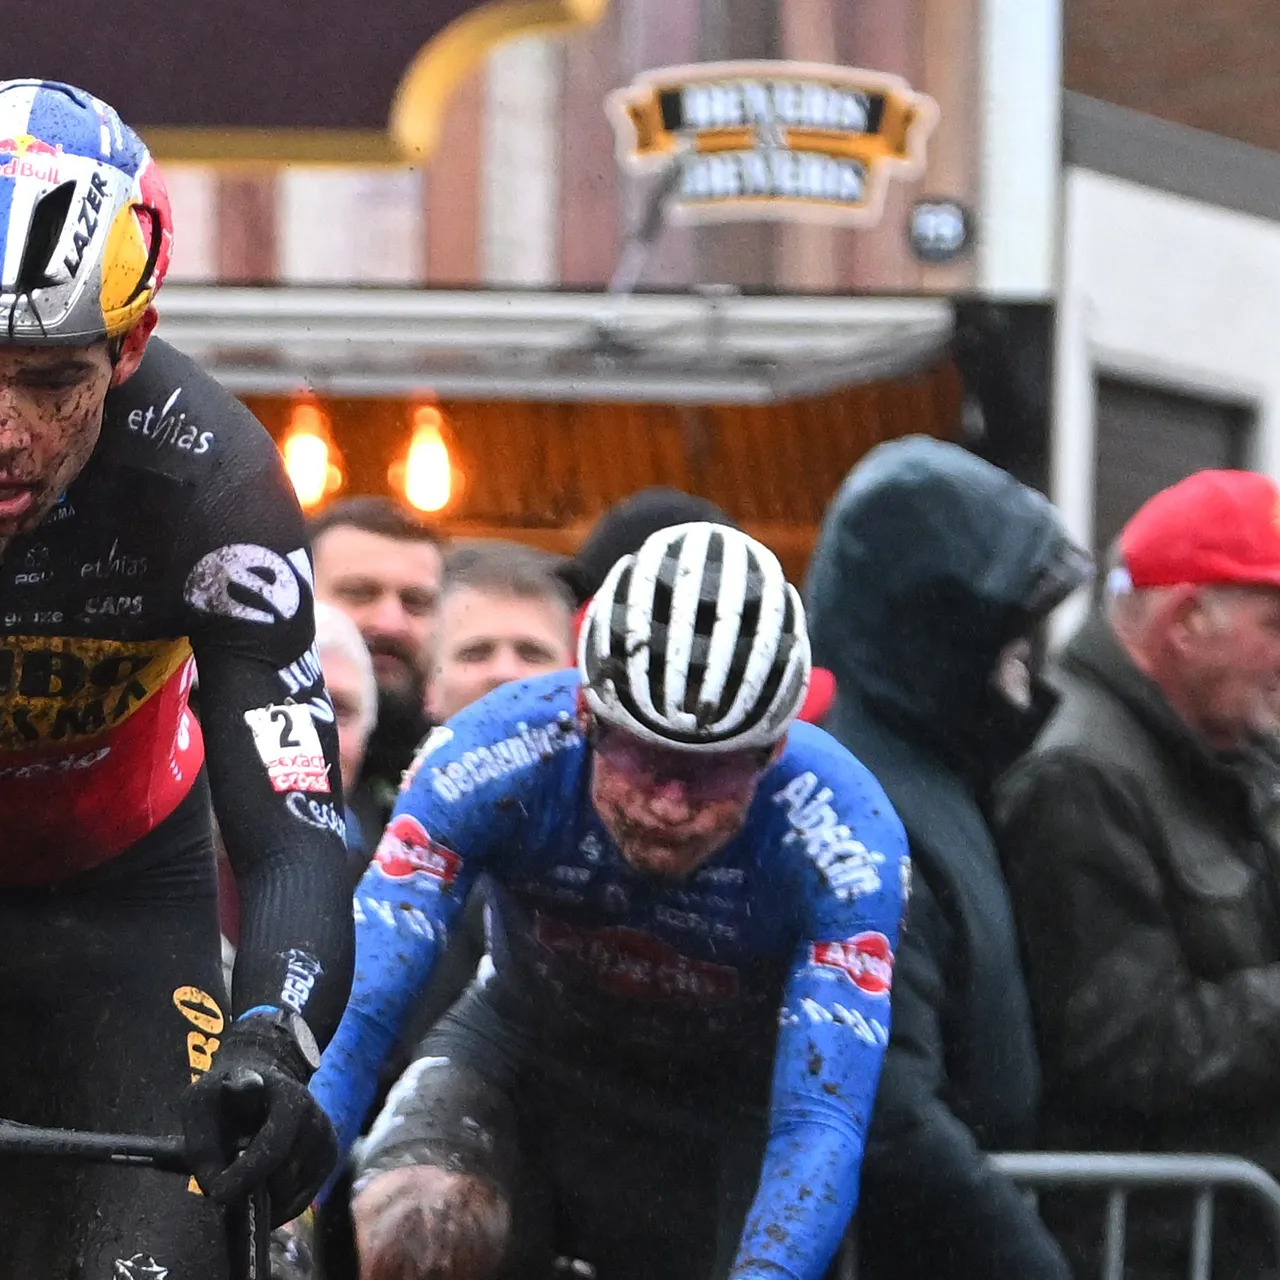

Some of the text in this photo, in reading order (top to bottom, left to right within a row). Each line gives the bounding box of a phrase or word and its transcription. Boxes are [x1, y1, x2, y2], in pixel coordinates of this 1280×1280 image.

[20, 161, 61, 184] Bull
[64, 171, 108, 279] LAZER
[127, 387, 214, 455] ethias
[270, 709, 302, 749] 2
